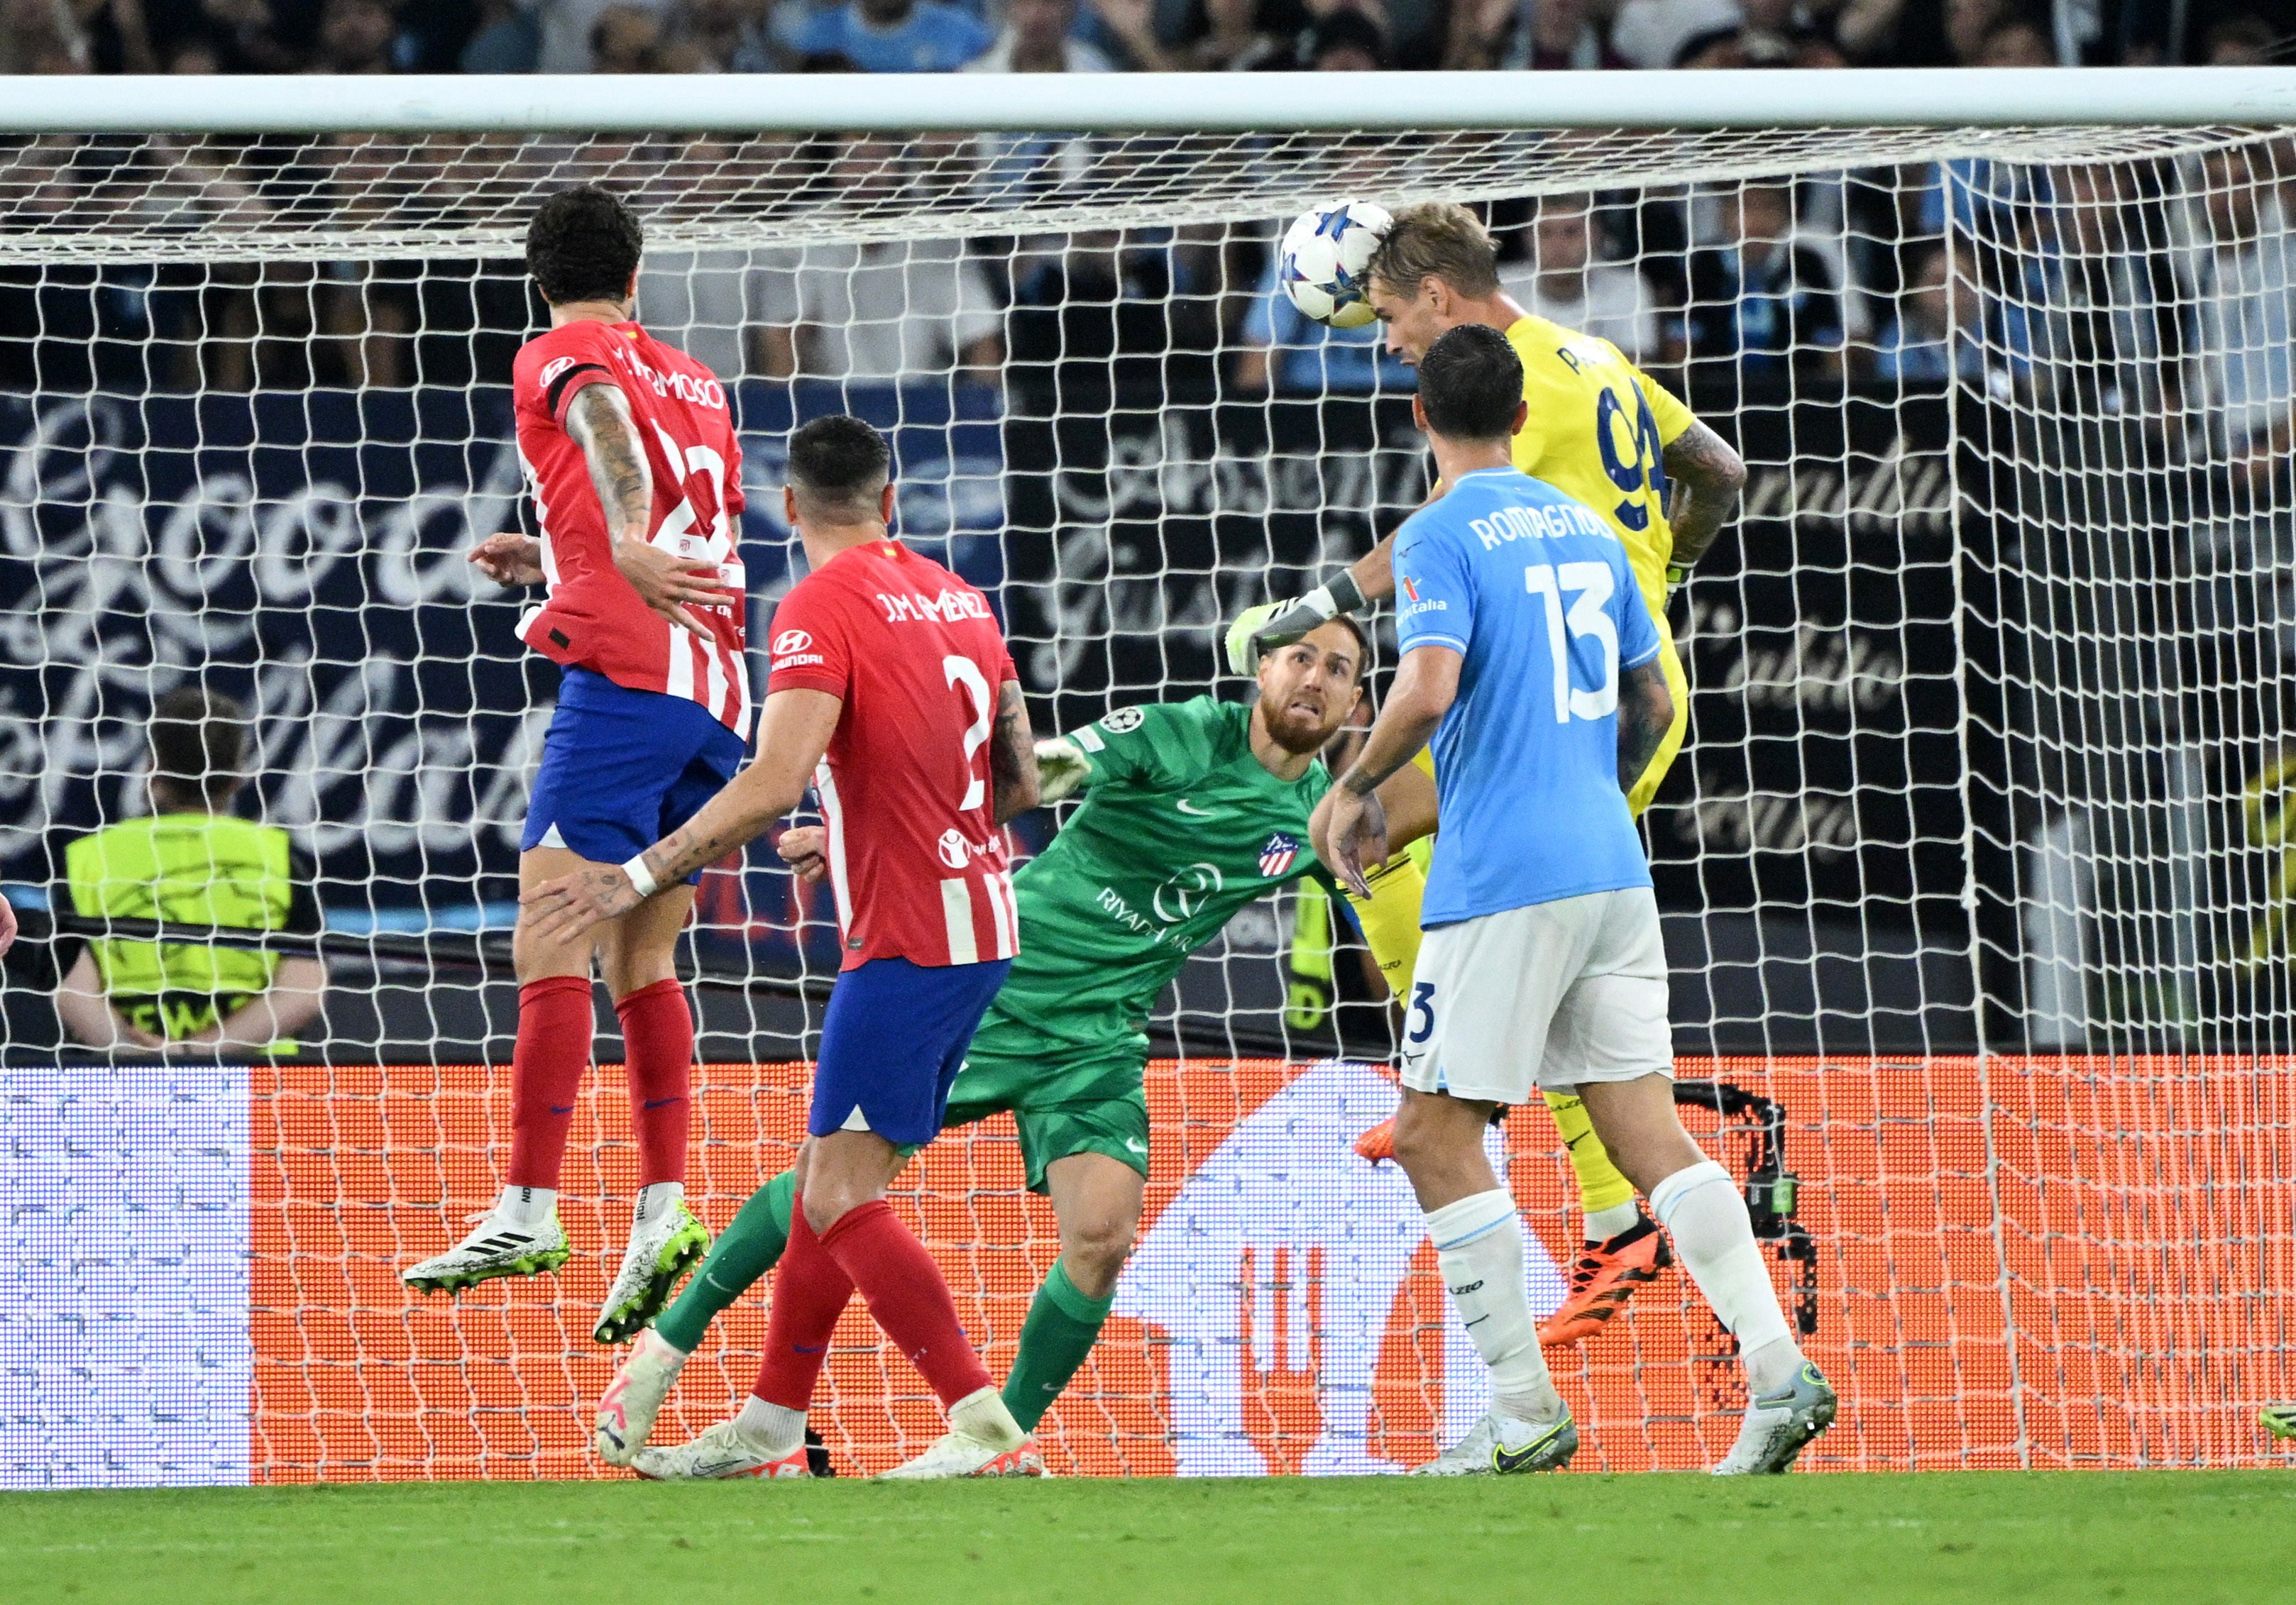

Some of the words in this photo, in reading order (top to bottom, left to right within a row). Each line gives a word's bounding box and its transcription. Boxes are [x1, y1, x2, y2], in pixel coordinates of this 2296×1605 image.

[647, 417, 732, 566] 22
[1524, 561, 1620, 724] 13
[943, 654, 991, 812] 2
[1096, 887, 1167, 943] RIYADH
[1402, 981, 1435, 1043] 3
